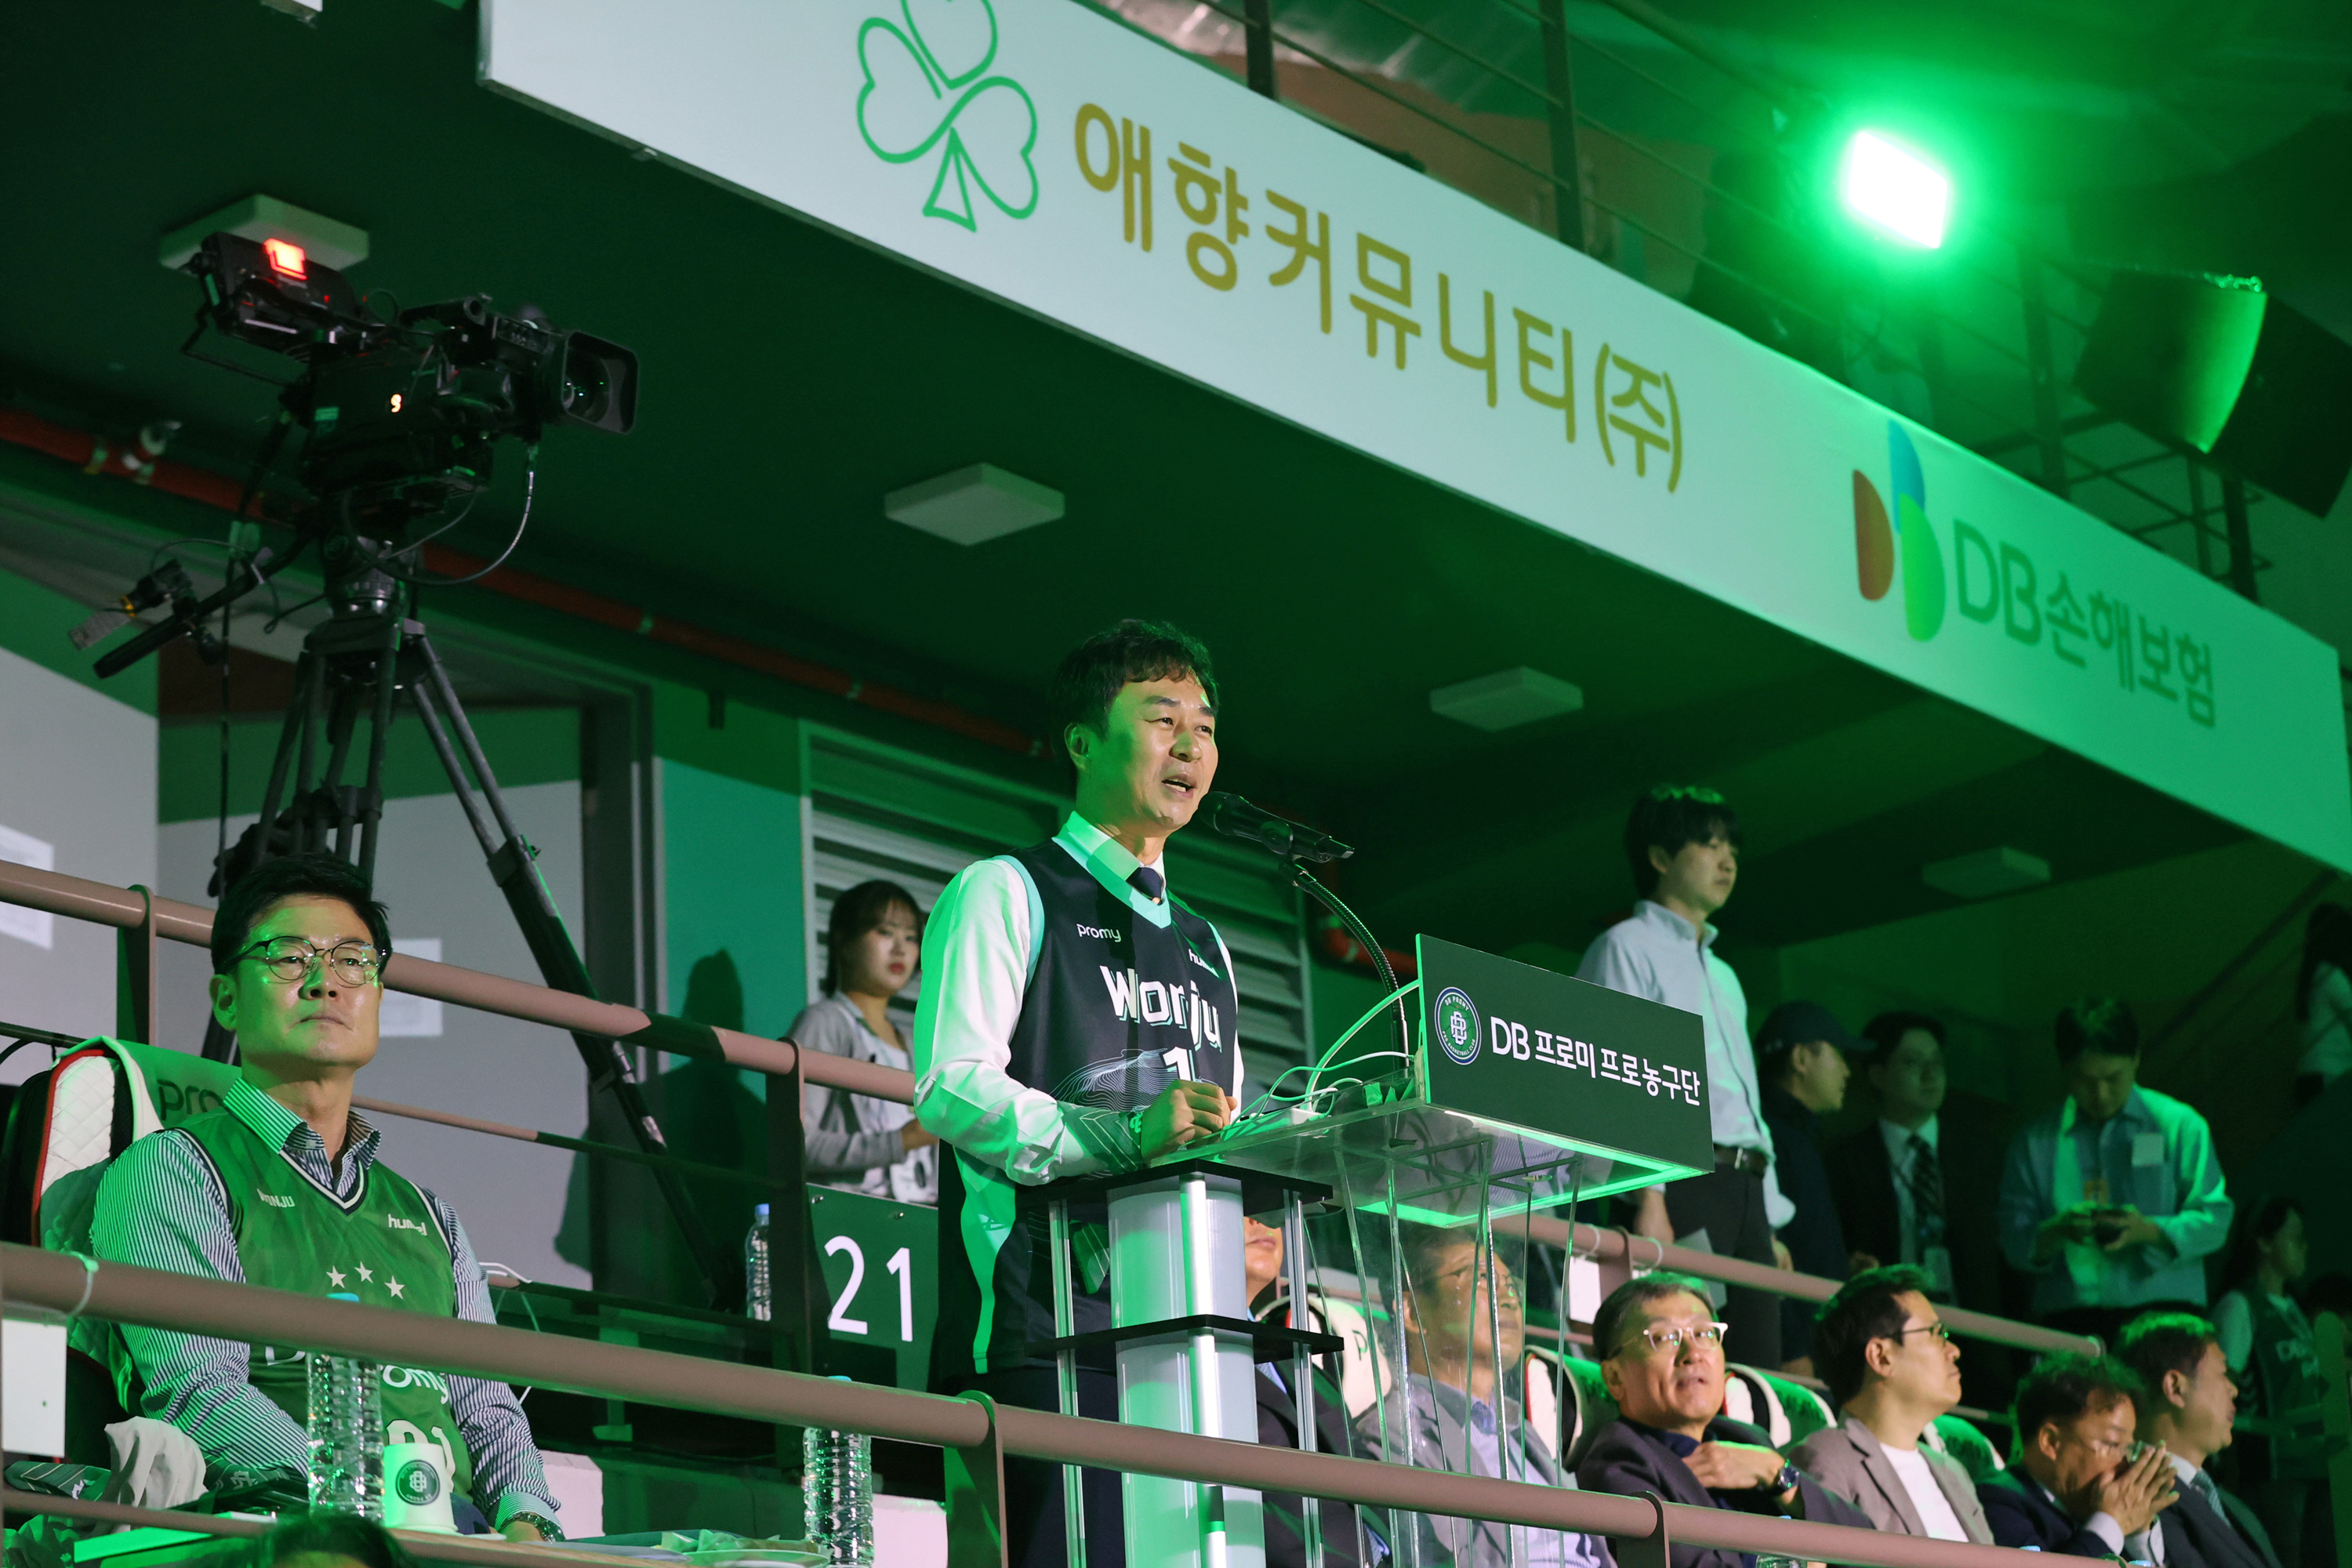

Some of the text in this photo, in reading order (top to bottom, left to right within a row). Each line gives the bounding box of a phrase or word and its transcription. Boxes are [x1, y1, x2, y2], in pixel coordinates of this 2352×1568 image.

[1075, 103, 1682, 493] 애향커뮤니티(주)
[1954, 519, 2215, 728] DB손해보험
[1076, 924, 1121, 942] promy
[1490, 1016, 1530, 1061] DB
[1534, 1029, 1596, 1079] 프로미
[157, 1079, 223, 1121] pro
[823, 1235, 913, 1342] 21
